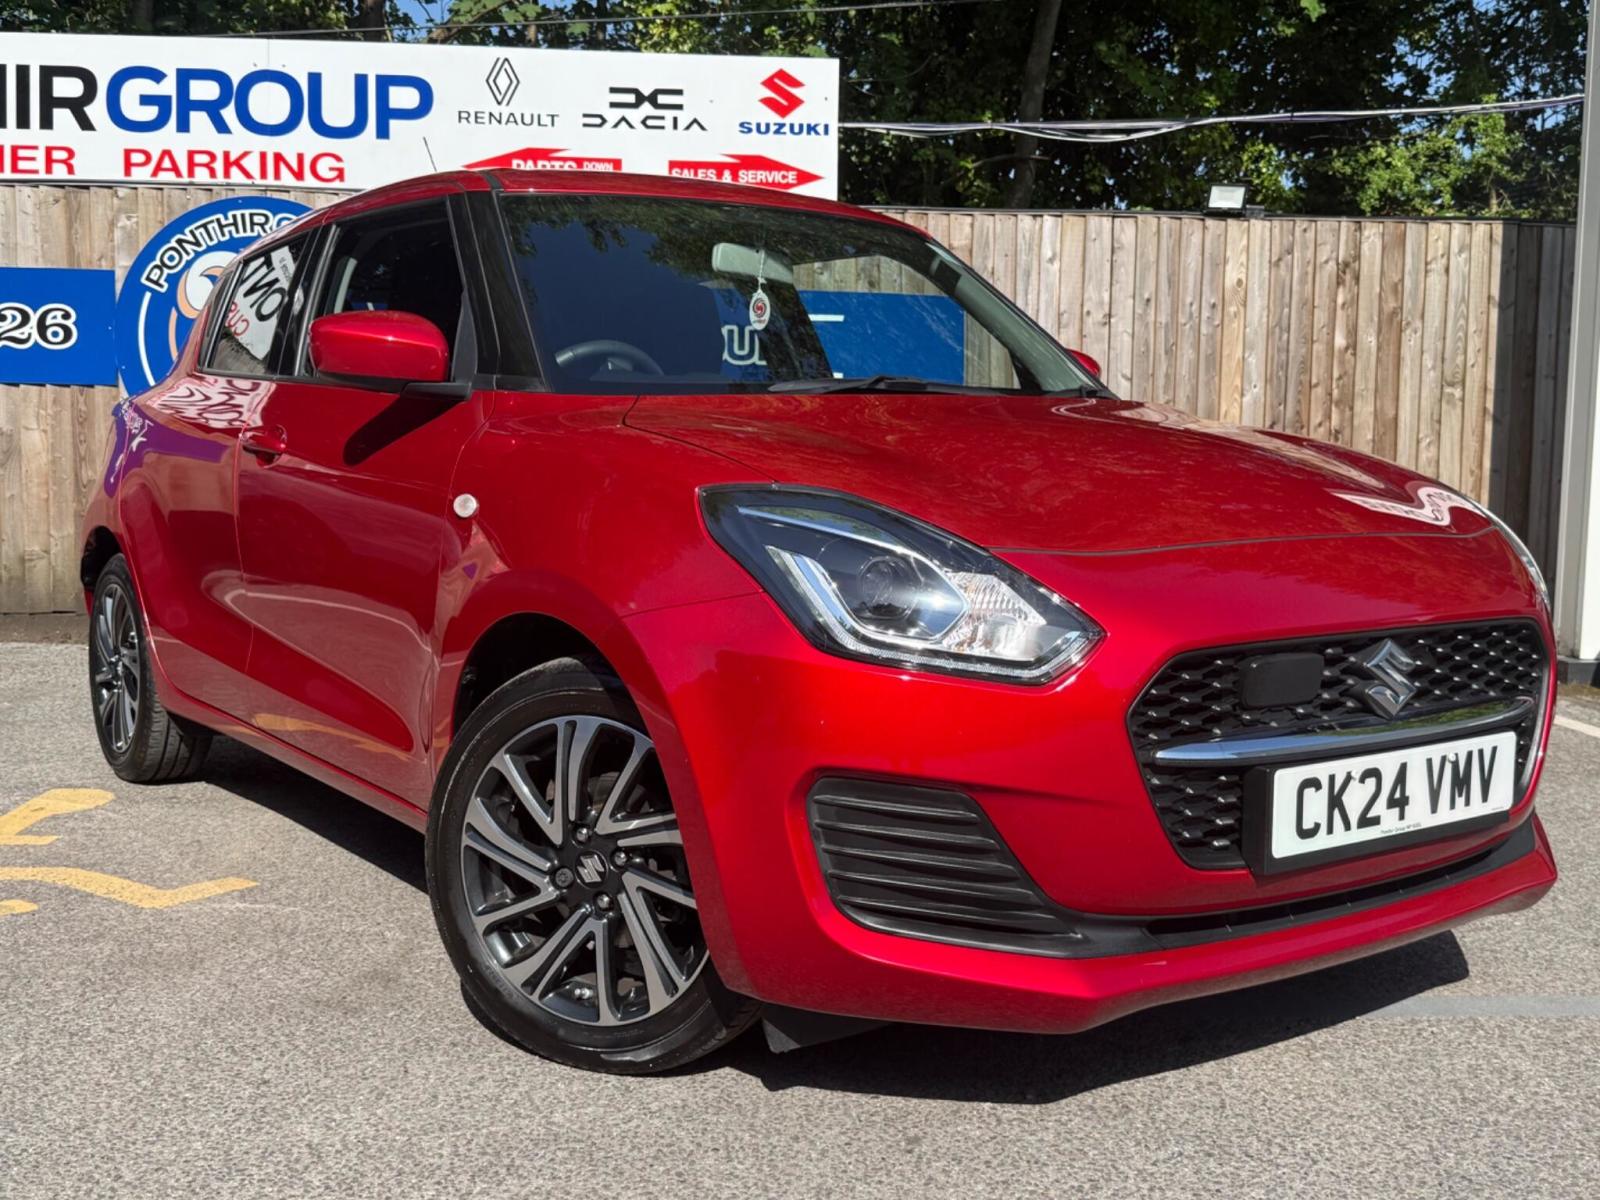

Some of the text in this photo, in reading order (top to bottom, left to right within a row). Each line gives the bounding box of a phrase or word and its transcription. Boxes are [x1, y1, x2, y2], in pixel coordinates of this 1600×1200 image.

[458, 110, 559, 128] RENAULT
[582, 113, 708, 131] DACIA
[738, 121, 830, 137] SUZUKI
[0, 145, 345, 182] ER PARKING
[738, 170, 798, 184] SERVICE
[1296, 745, 1498, 840] CK24 VMV
